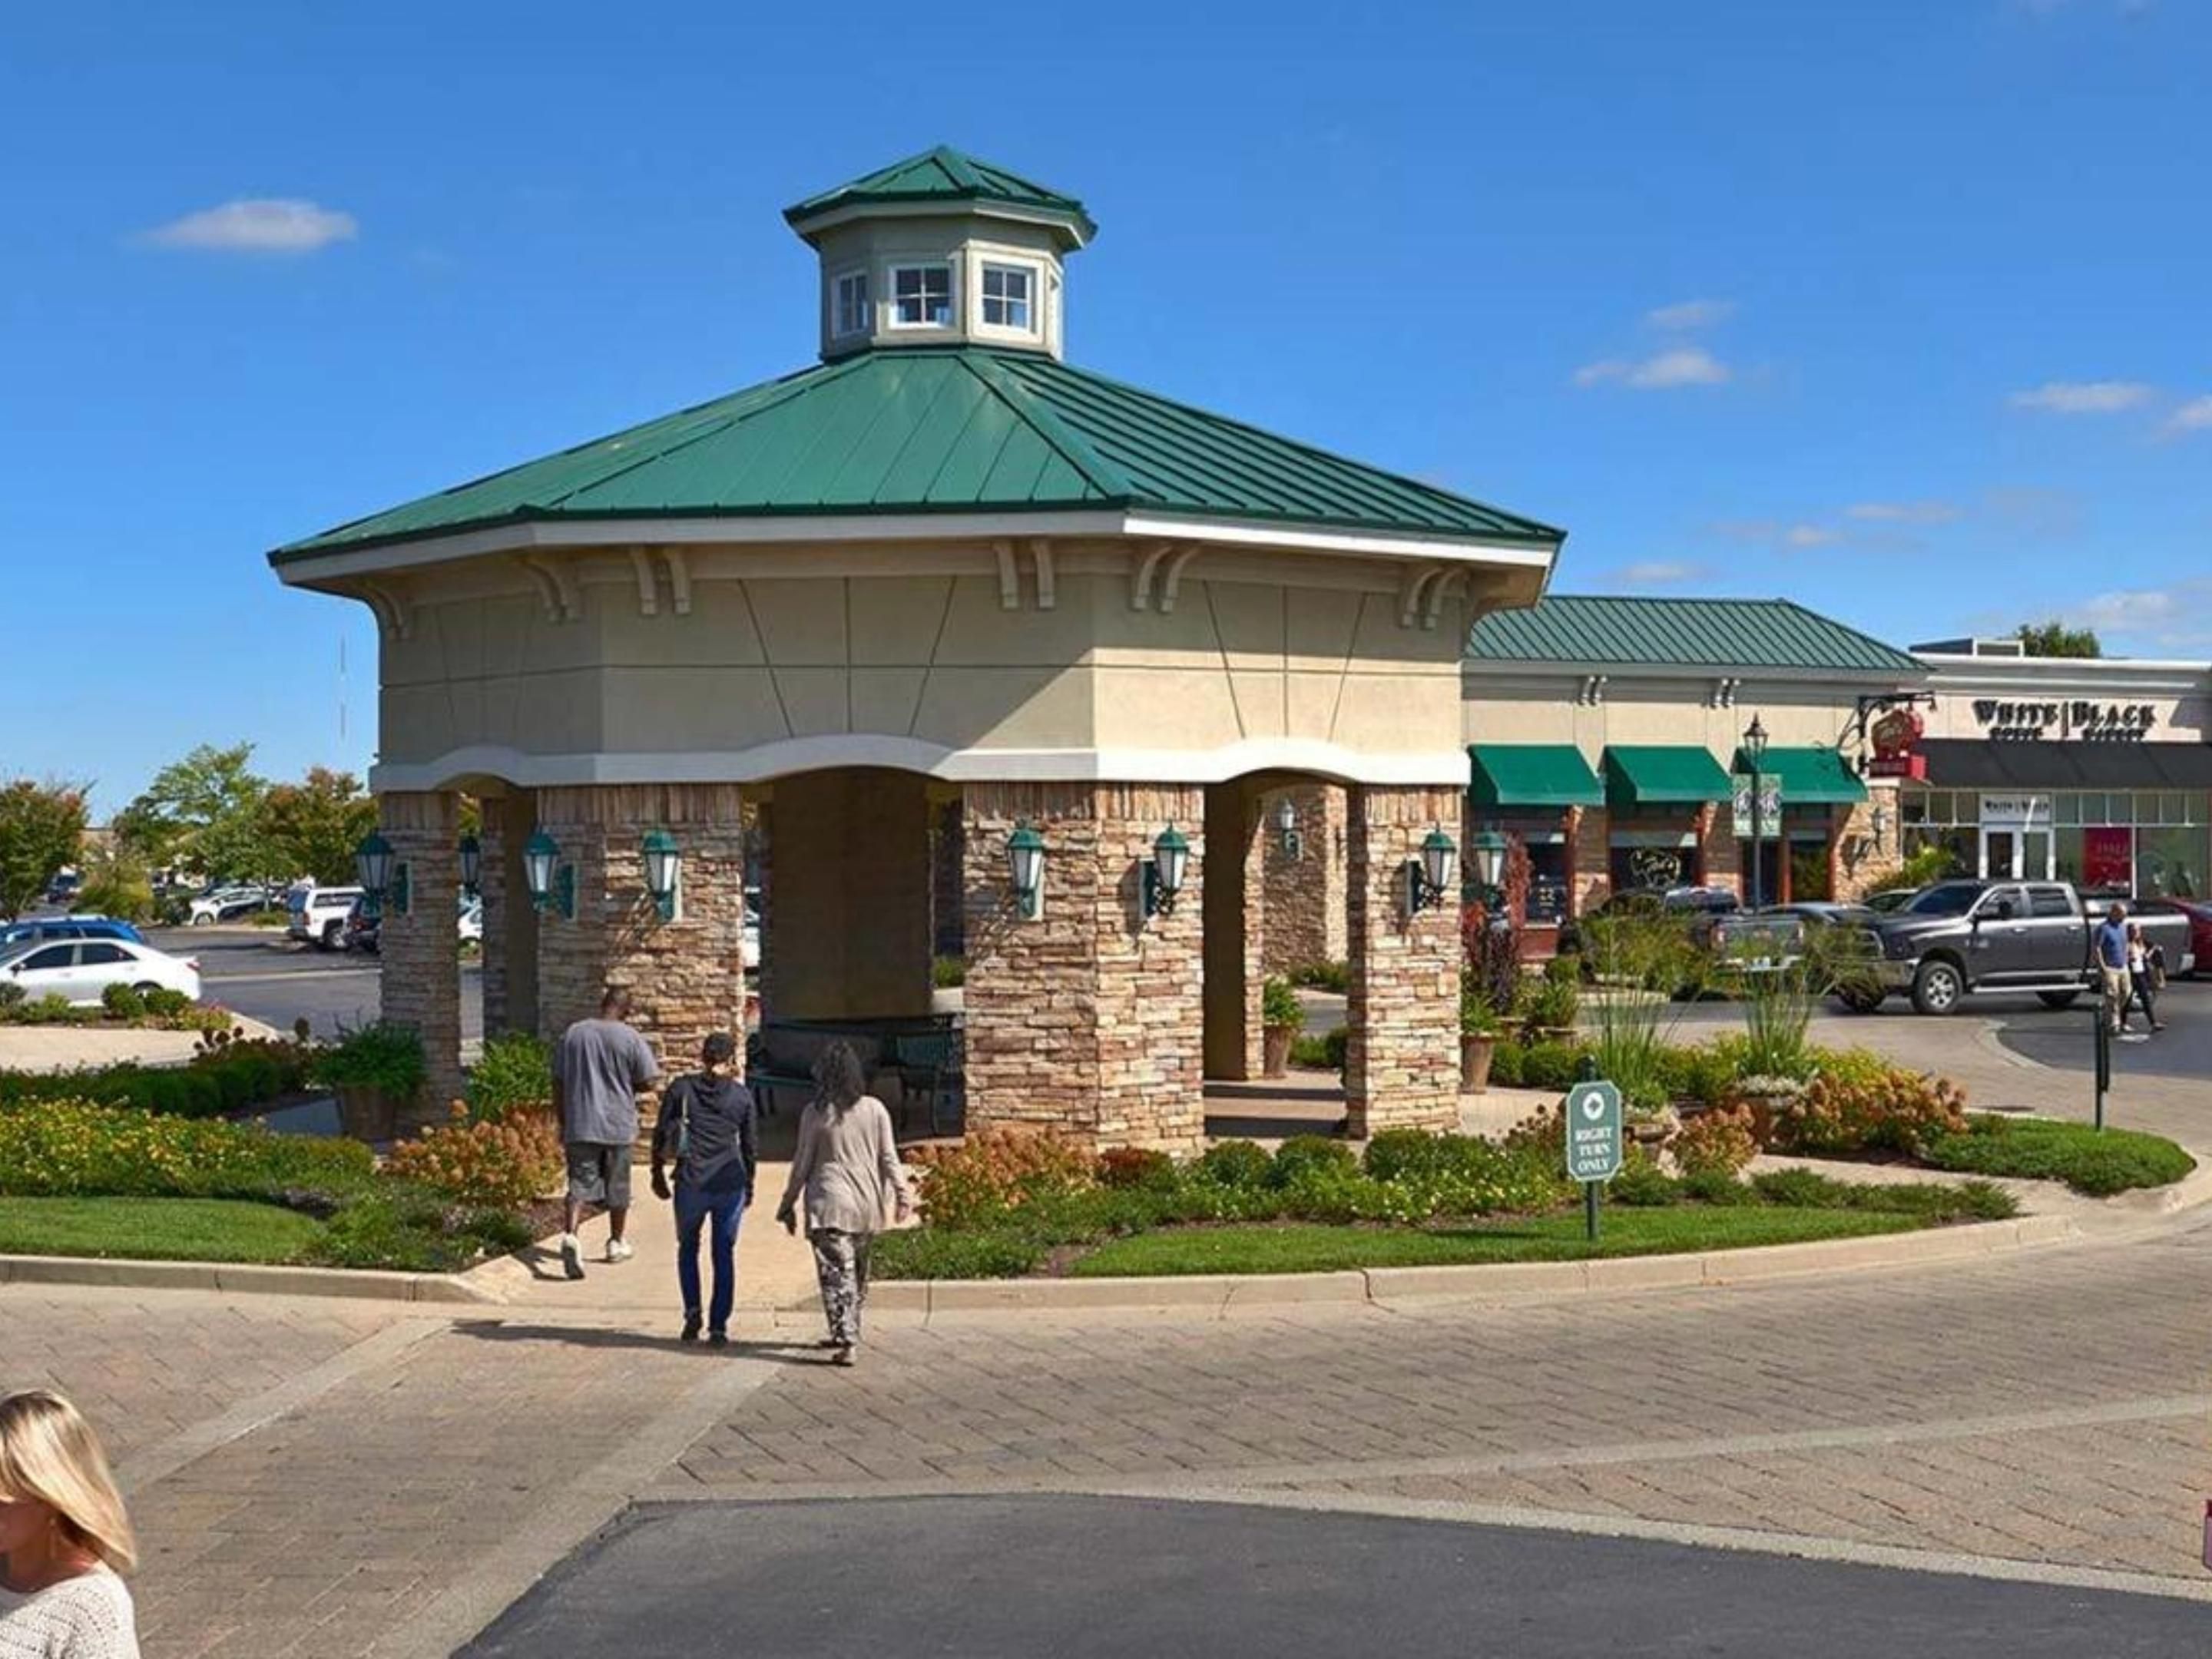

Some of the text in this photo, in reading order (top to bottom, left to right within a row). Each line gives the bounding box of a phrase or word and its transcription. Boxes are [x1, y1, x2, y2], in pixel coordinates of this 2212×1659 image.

[1972, 700, 2157, 727] WHITE BLACK
[1580, 1143, 1611, 1156] TURN
[1578, 1159, 1608, 1172] ONLY
